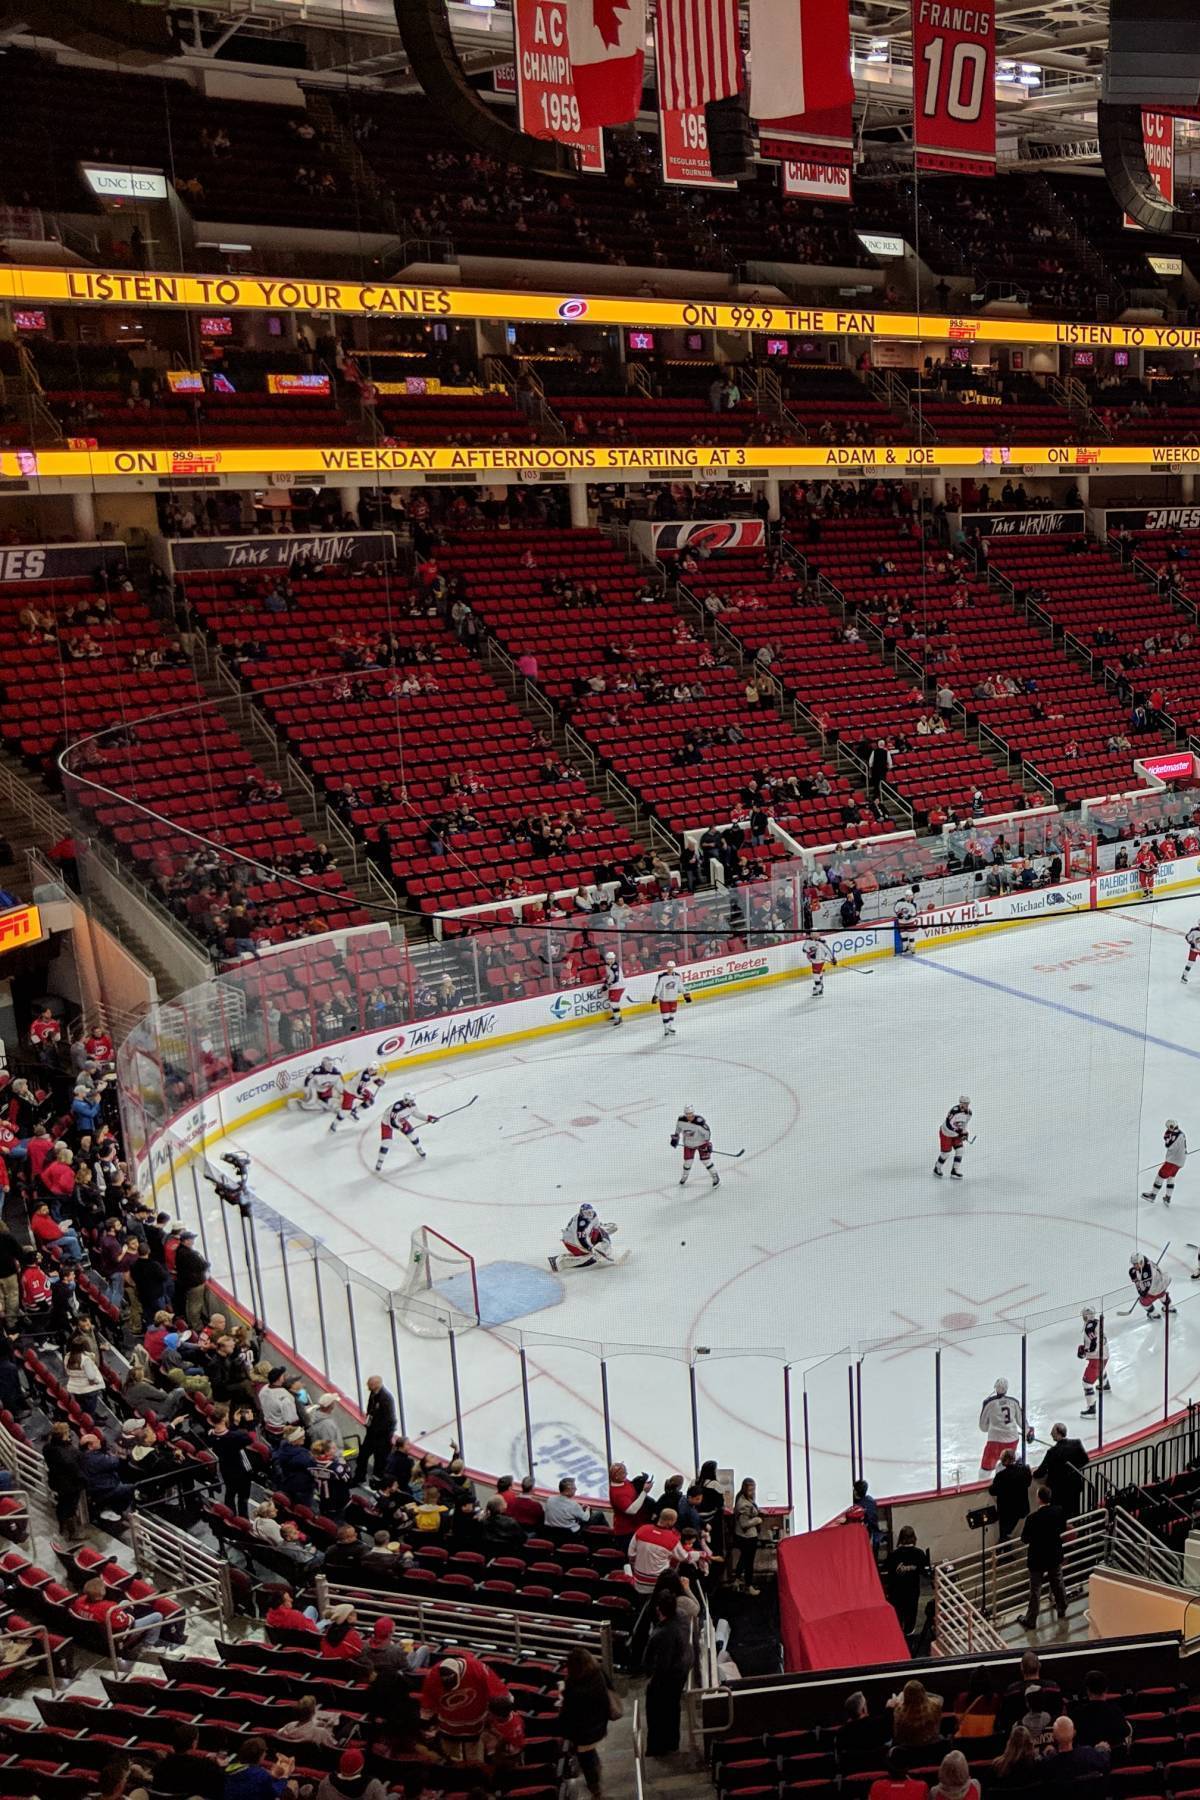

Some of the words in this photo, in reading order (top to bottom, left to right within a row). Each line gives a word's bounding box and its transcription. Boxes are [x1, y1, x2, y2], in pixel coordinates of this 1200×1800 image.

[919, 1, 989, 35] FRANCIS
[924, 37, 987, 121] 10
[541, 91, 581, 132] 1959
[97, 176, 128, 190] UNC
[130, 178, 156, 193] REX
[789, 162, 847, 187] CHAMPIONS
[882, 241, 898, 252] REX
[1167, 262, 1182, 273] REX
[68, 273, 178, 301] LISTEN
[197, 279, 240, 305] TO
[258, 282, 342, 309] YOUR
[359, 286, 452, 315] CANES
[683, 304, 718, 327] ON
[730, 306, 773, 329] 99.9
[785, 310, 825, 332] THE
[836, 314, 876, 333] FAN
[1057, 324, 1112, 344] LISTEN
[1123, 327, 1145, 346] TO
[114, 452, 158, 472] ON
[172, 451, 194, 461] 99.9
[321, 450, 437, 469] WEEKDAY
[451, 449, 596, 468] AFTERNOONS
[607, 449, 698, 467] STARTING
[709, 449, 734, 465] AT
[736, 449, 746, 465] 3
[826, 448, 877, 465] ADAM
[885, 448, 897, 464] &
[905, 448, 935, 464] JOE
[1048, 448, 1069, 463] ON
[523, 470, 538, 480] 103
[989, 517, 1017, 536] TAKE
[1020, 512, 1064, 536] WARNING
[225, 543, 270, 567] TAKE
[277, 536, 357, 565] WARNING
[1100, 872, 1130, 890] RALEIGH
[1010, 899, 1045, 916] Michael
[1066, 890, 1083, 902] Son
[924, 919, 980, 938] VINEYARDS
[832, 929, 878, 954] pepsi
[681, 965, 723, 982] Harris
[726, 957, 768, 973] Teeter
[574, 999, 610, 1017] ENERG
[408, 1027, 440, 1050] TAKE
[441, 1011, 499, 1047] WARNING
[236, 1080, 276, 1103] VECTOR
[1002, 1406, 1012, 1425] 3
